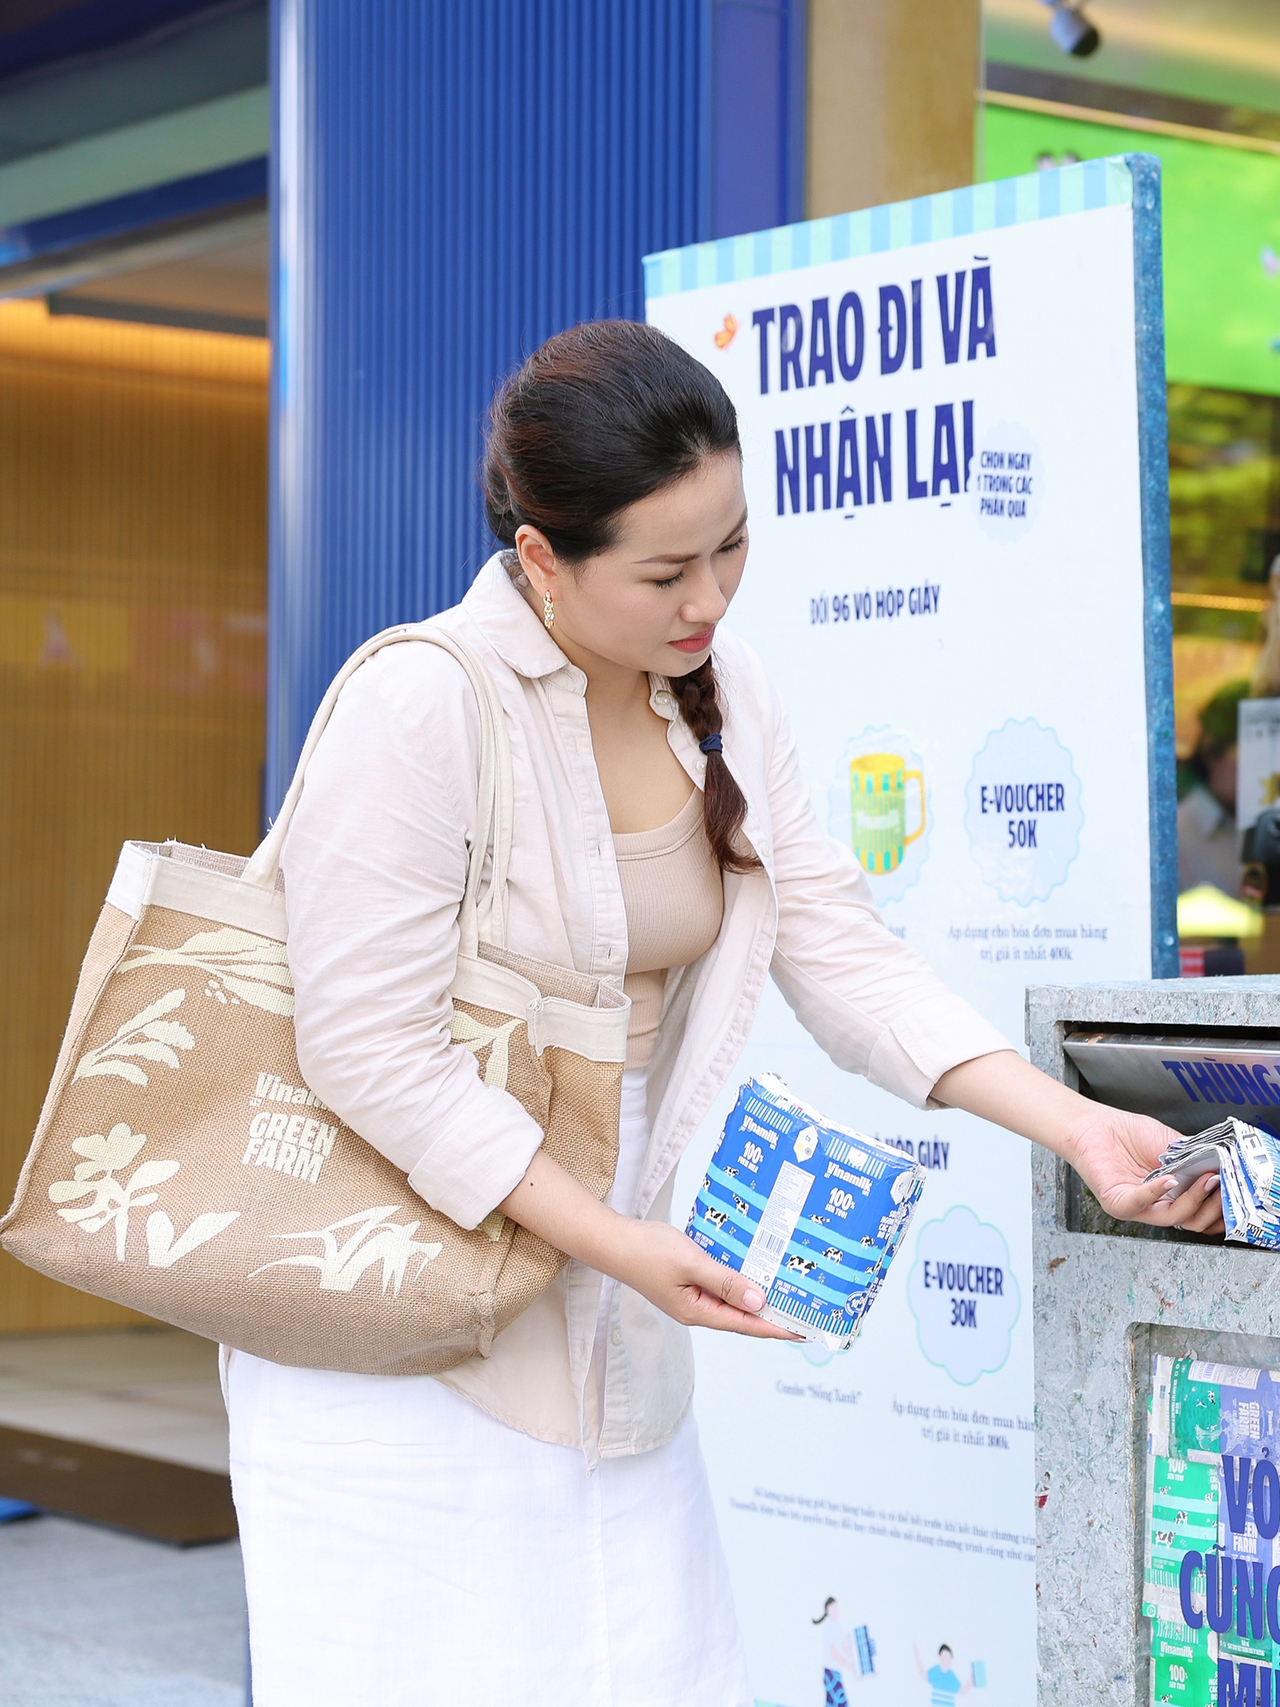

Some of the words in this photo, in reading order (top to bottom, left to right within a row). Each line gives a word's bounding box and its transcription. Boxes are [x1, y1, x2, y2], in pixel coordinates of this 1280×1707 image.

[752, 291, 864, 395] TRAO
[878, 278, 923, 375] ĐI
[936, 254, 997, 365] VÀ
[775, 405, 892, 519] NHẬN
[906, 400, 975, 508] LẠI
[833, 594, 850, 622] 96
[980, 782, 1065, 814] E-VOUCHER
[1008, 819, 1038, 849] 50K
[249, 1112, 339, 1157] GREEN
[740, 1114, 780, 1146] Vinamilk
[242, 1139, 325, 1184] FARM
[826, 1161, 873, 1192] Vinamilk
[923, 1261, 1004, 1296] E-VOUCHER
[950, 1298, 978, 1328] 30K
[1249, 1402, 1261, 1439] GREEN
[1233, 1537, 1257, 1554] FARM
[1160, 1641, 1193, 1658] Vinamilk
